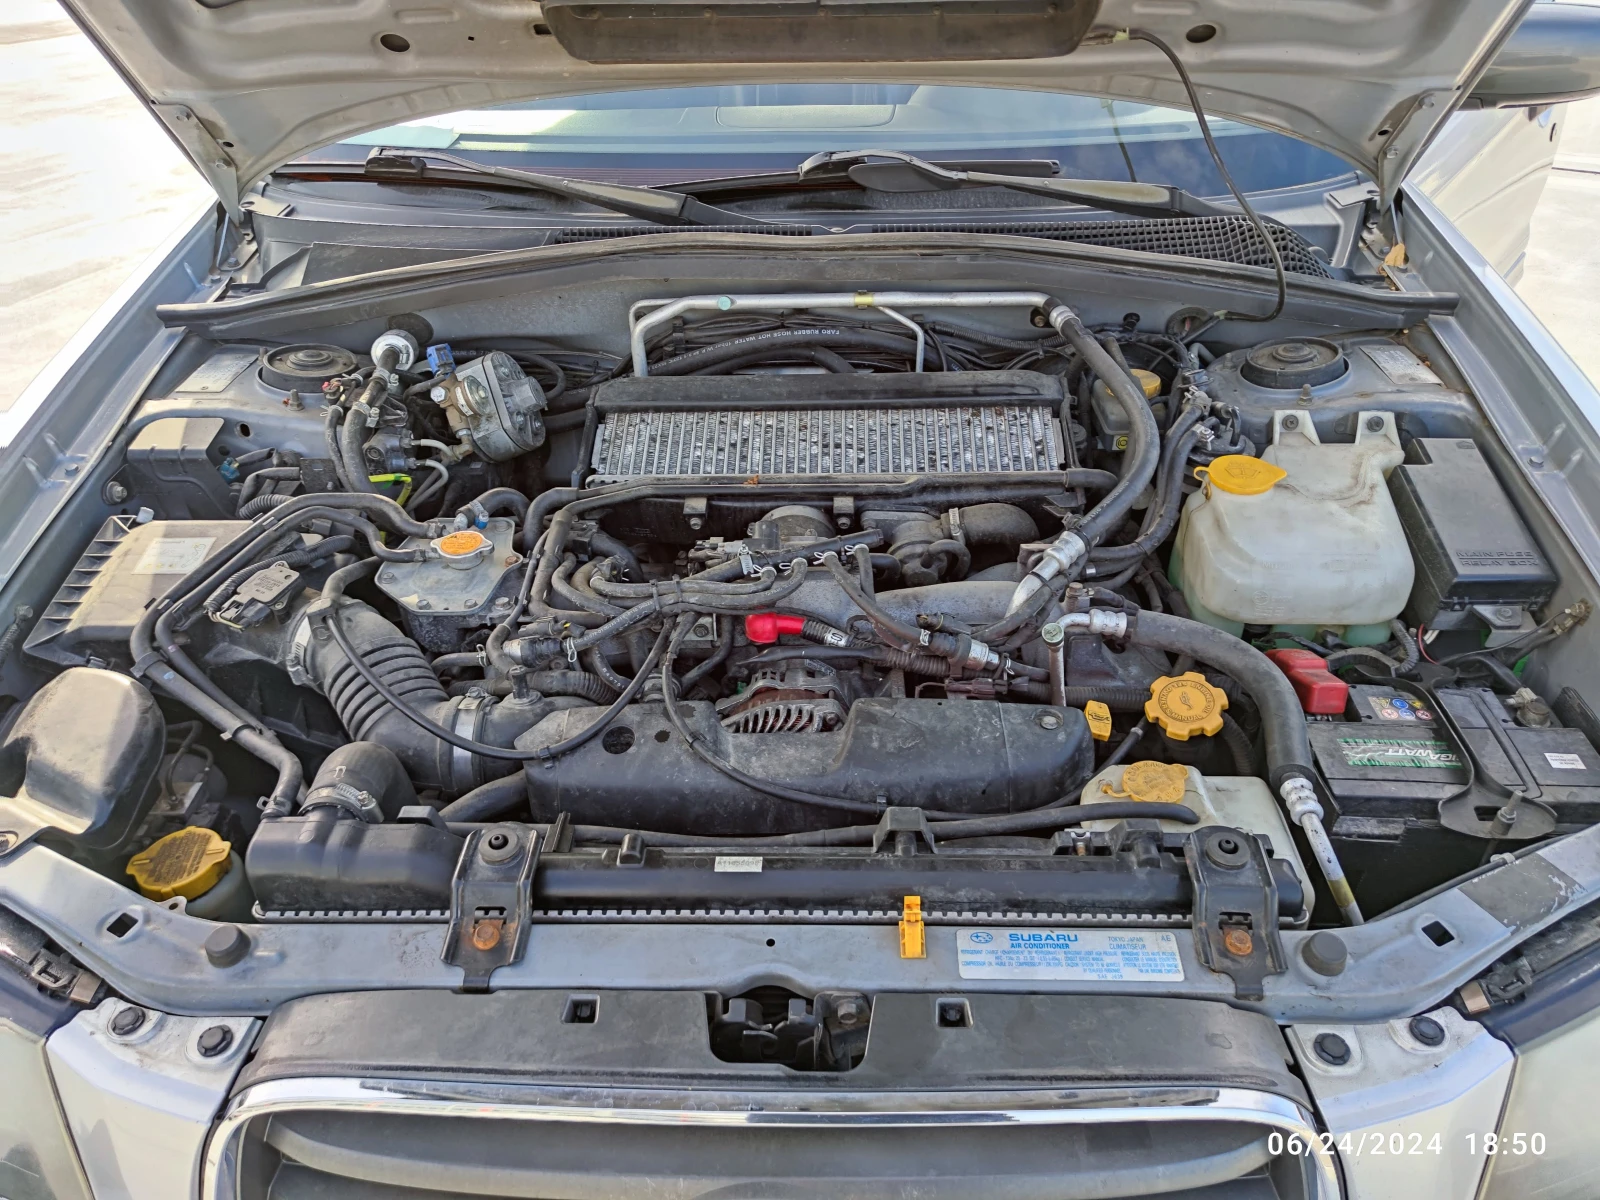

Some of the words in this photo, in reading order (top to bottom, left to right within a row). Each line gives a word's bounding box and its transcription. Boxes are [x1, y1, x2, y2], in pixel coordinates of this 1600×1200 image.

[734, 336, 757, 345] WATER
[1384, 748, 1460, 761] IGAWATT
[1009, 934, 1078, 942] SUBARU
